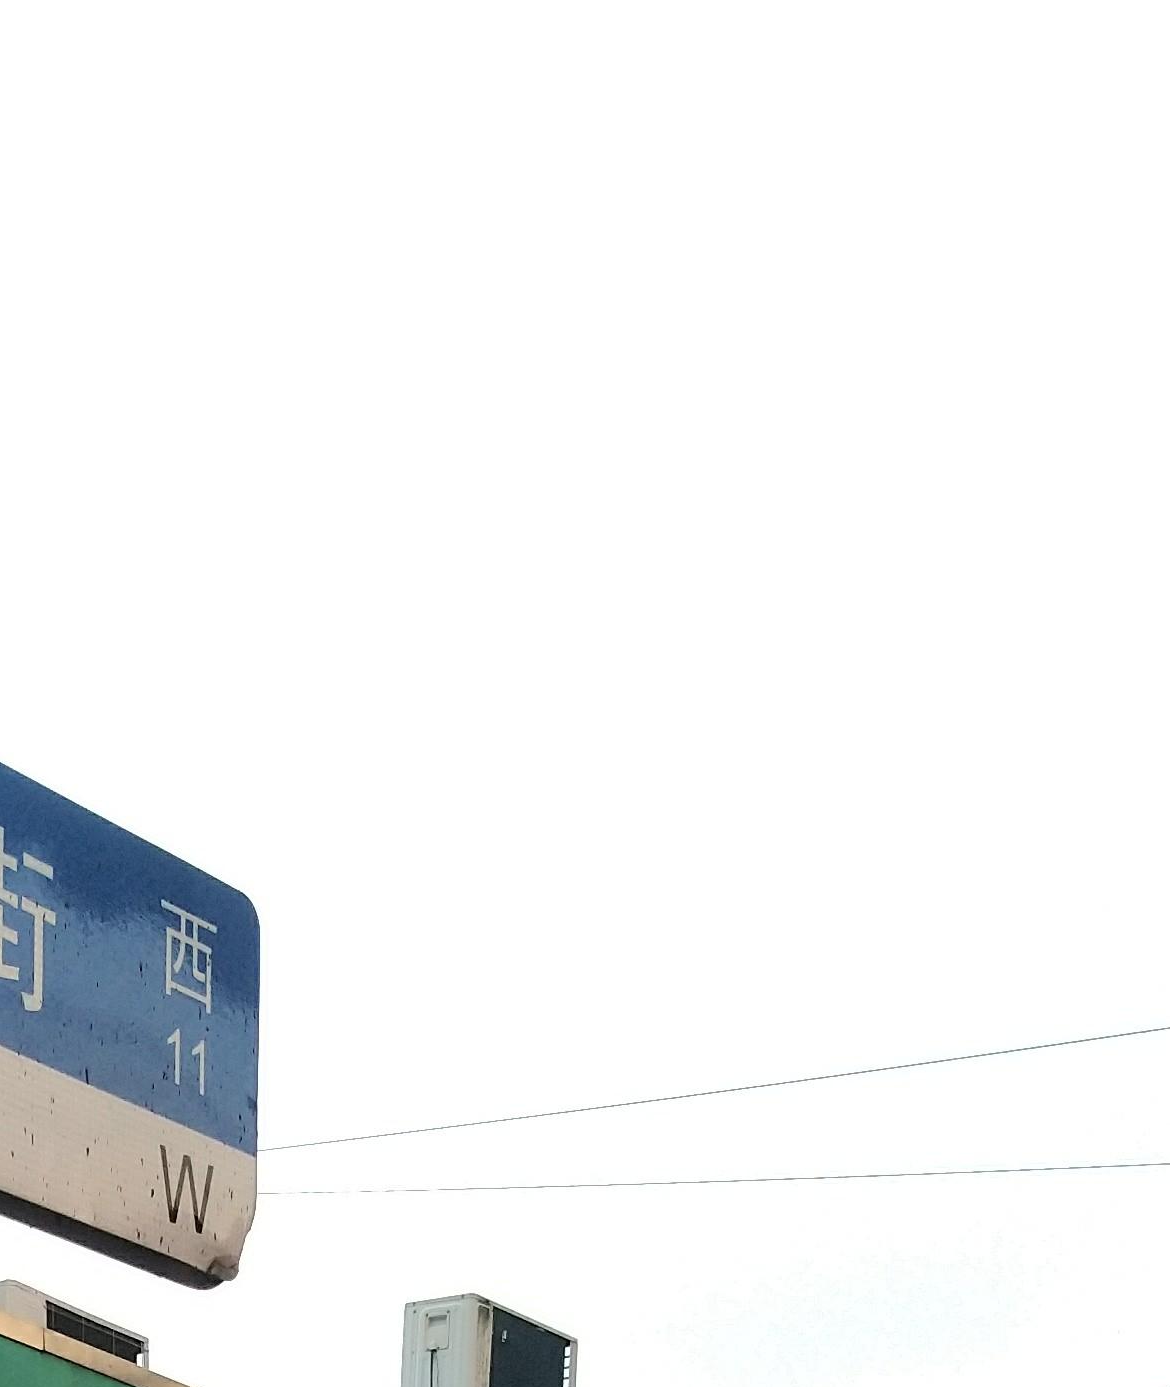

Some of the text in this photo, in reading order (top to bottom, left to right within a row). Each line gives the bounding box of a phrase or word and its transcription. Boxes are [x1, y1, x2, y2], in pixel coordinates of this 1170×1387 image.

[160, 899, 218, 1015] 西
[167, 1030, 207, 1097] 11
[159, 1143, 214, 1236] W
